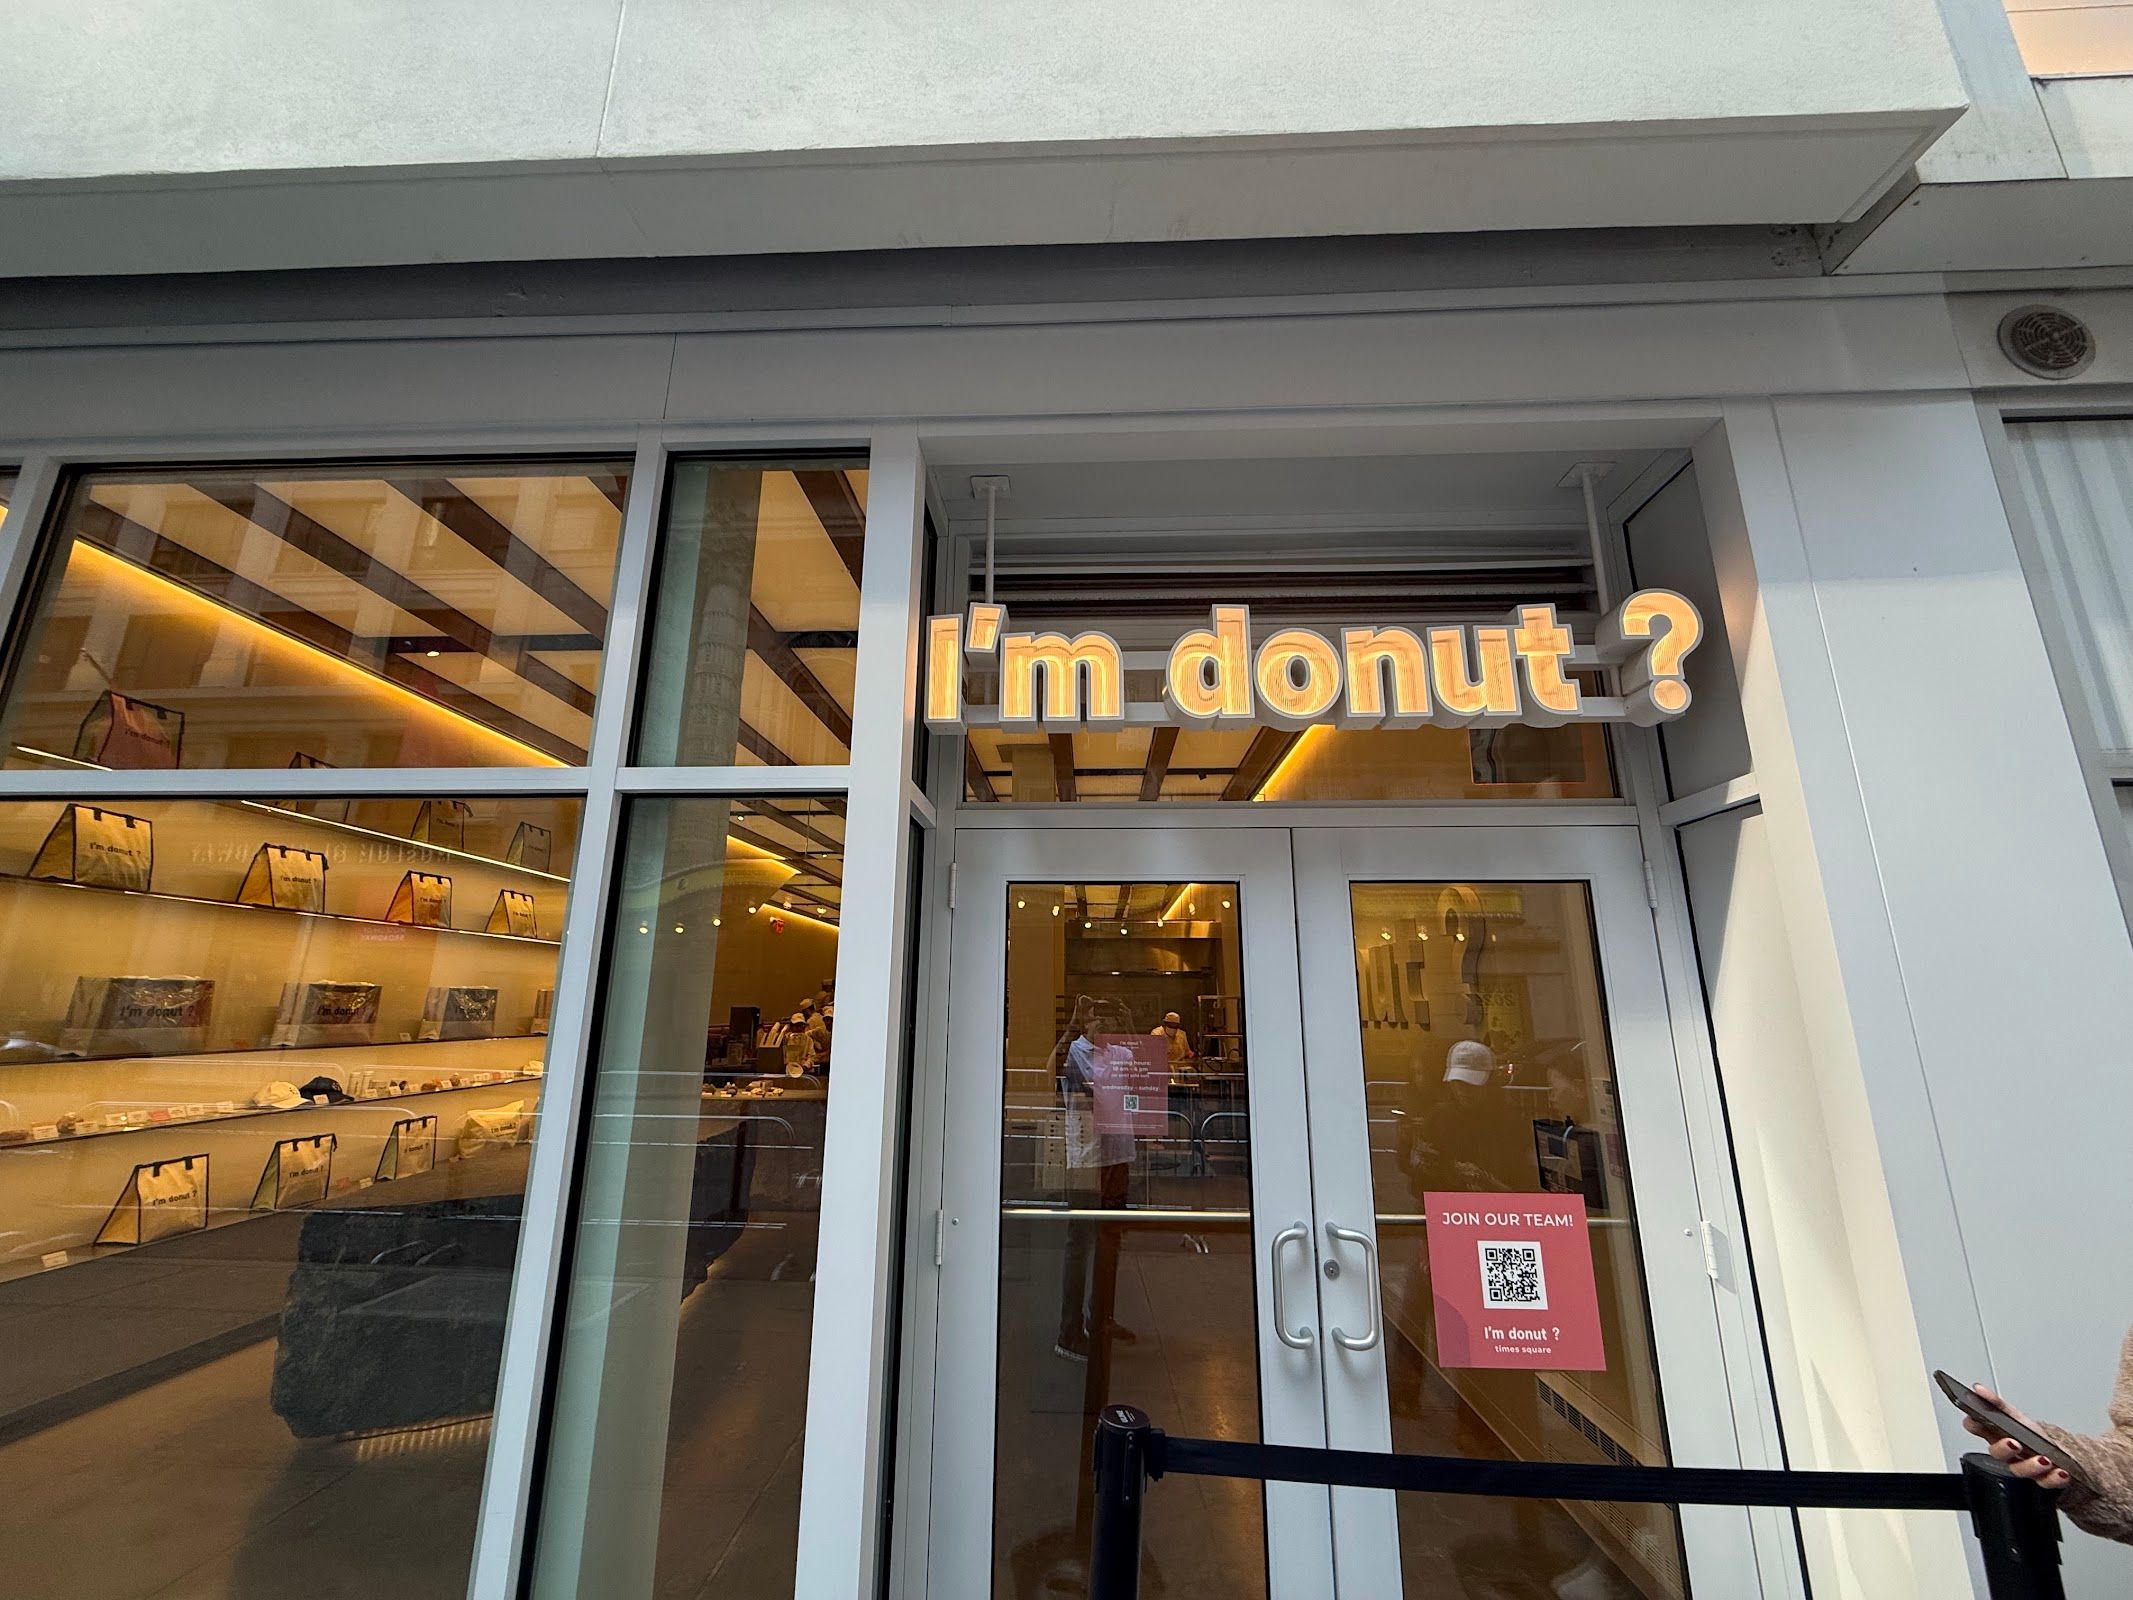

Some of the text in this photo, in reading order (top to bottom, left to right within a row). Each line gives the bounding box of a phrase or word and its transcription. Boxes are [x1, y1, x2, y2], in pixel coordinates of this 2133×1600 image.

[926, 588, 1704, 730] I'm donut ?
[90, 841, 105, 851] I'm
[119, 1006, 143, 1018] I'm
[145, 1006, 183, 1018] donut
[152, 1198, 167, 1206] I'm
[168, 1192, 190, 1203] donut
[1442, 1212, 1574, 1227] JOIN OUR TEAM!
[1484, 1325, 1561, 1341] I'm donut ?
[1494, 1344, 1552, 1354] times square
